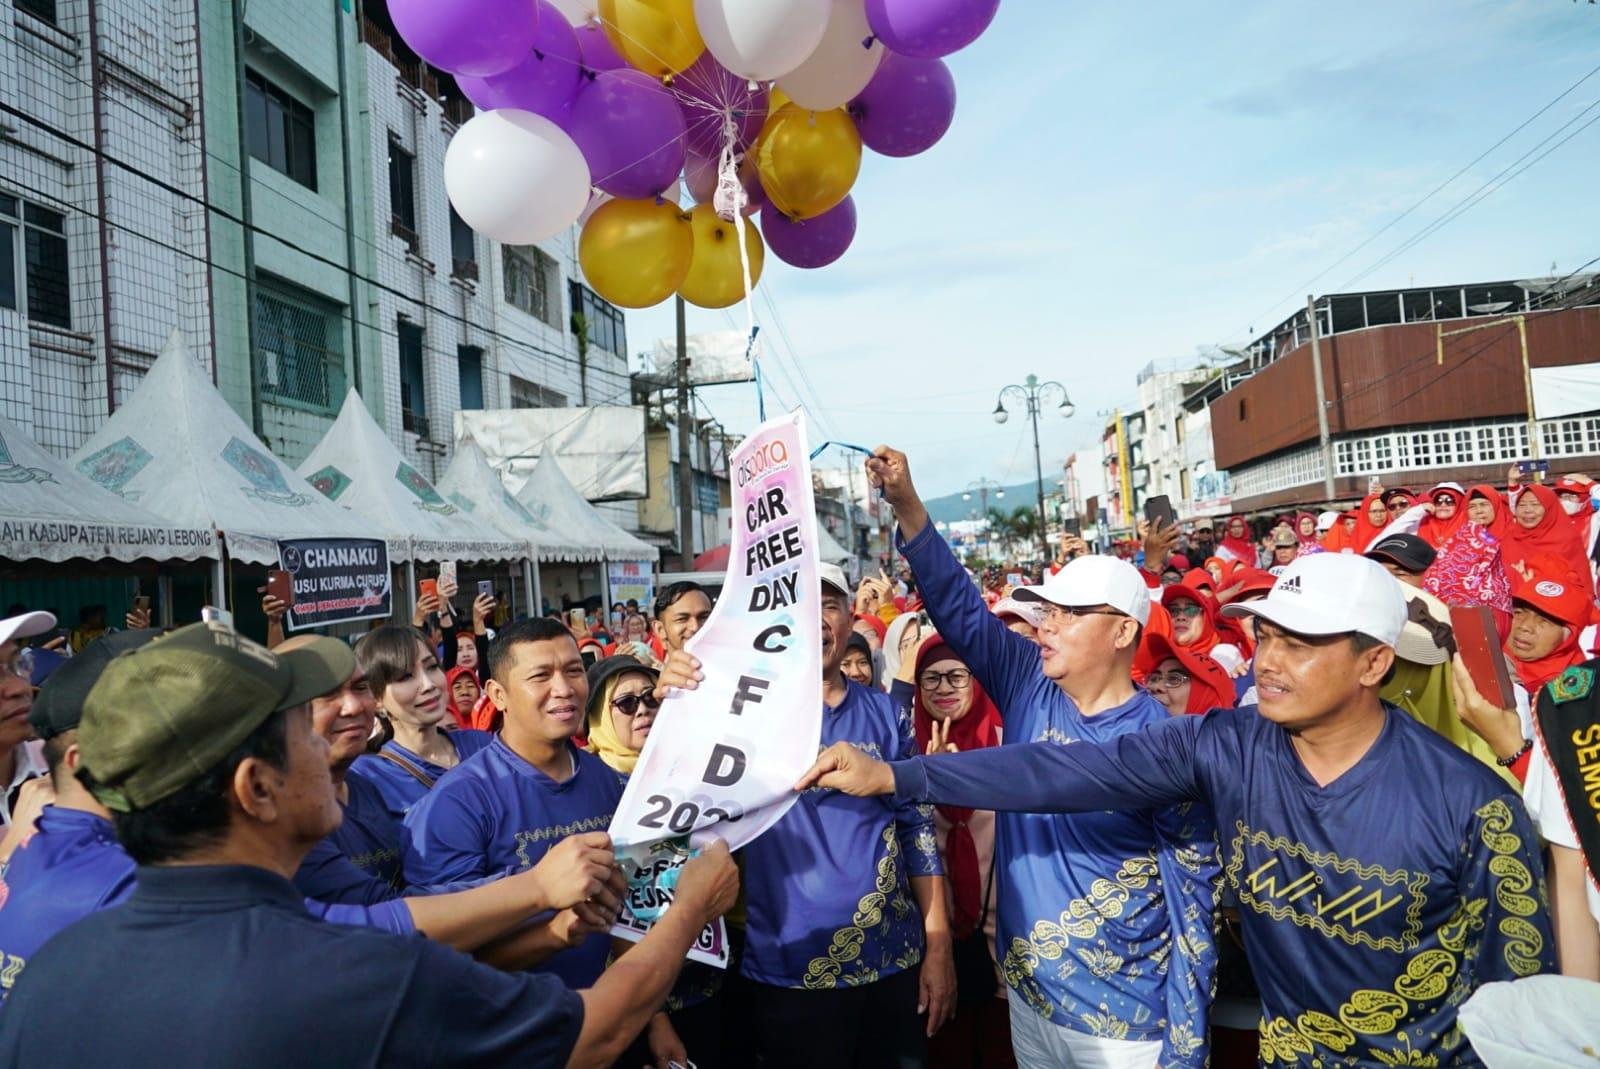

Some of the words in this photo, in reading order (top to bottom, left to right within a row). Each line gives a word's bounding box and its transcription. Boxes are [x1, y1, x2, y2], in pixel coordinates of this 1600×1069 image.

[746, 487, 789, 533] CAR
[29, 523, 115, 545] KABUPATEN
[119, 527, 165, 545] REJANG
[167, 529, 211, 547] LEBONG
[745, 526, 803, 576] FREE
[304, 548, 379, 569] CHANAKU
[294, 578, 318, 594] USU
[320, 575, 356, 591] KURMA
[748, 572, 799, 613] DAY
